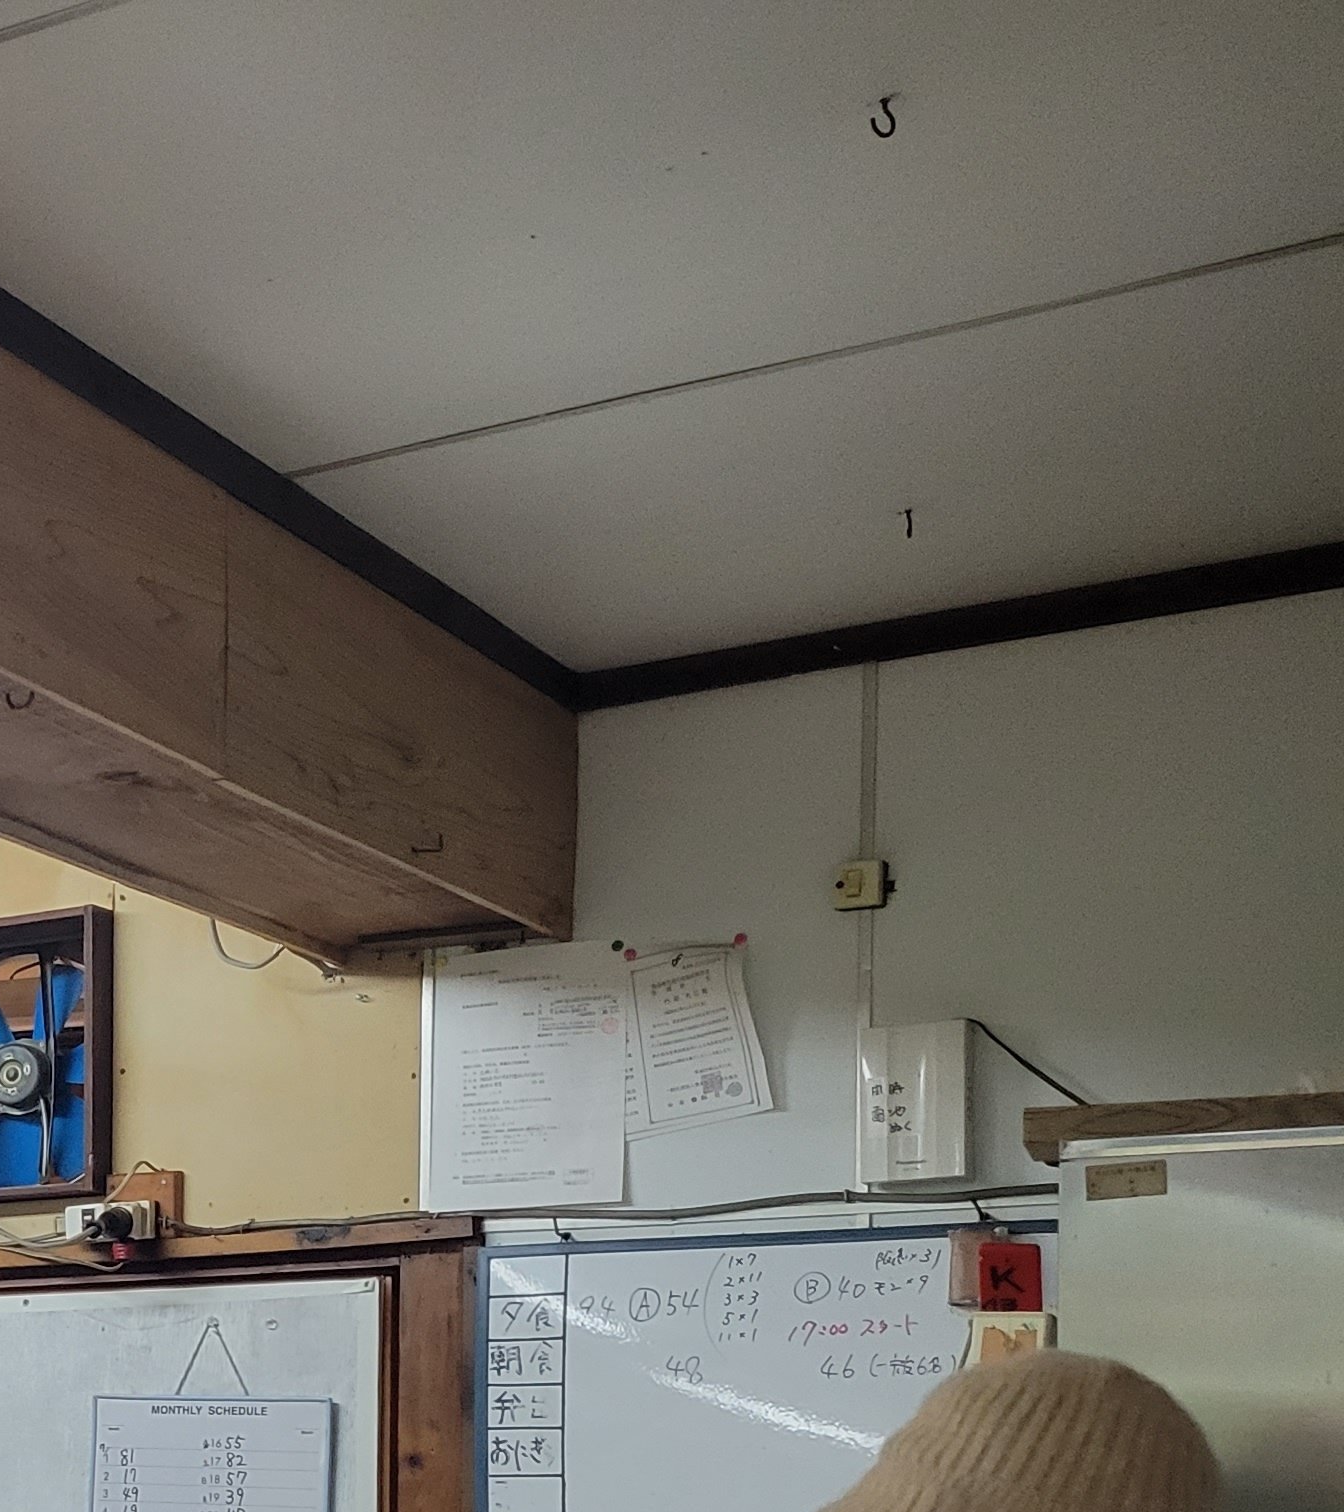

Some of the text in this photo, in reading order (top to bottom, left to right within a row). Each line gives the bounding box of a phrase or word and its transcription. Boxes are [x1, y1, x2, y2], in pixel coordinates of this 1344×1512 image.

[990, 1264, 1025, 1293] K
[838, 1276, 866, 1301] 40
[666, 1288, 700, 1316] 54
[501, 1297, 555, 1335] 夕食
[490, 1341, 553, 1376] 朝食
[820, 1354, 855, 1379] 46
[666, 1355, 703, 1384] 48
[151, 1405, 268, 1416] MONTHLY SCHEDULE
[211, 1435, 246, 1449] 16 55
[120, 1448, 134, 1466] 81
[211, 1452, 247, 1466] 17 82
[103, 1468, 137, 1483] 2 17
[210, 1474, 220, 1484] 18
[226, 1471, 247, 1486] 57
[103, 1487, 139, 1502] 3 49
[209, 1487, 244, 1506] 19 39
